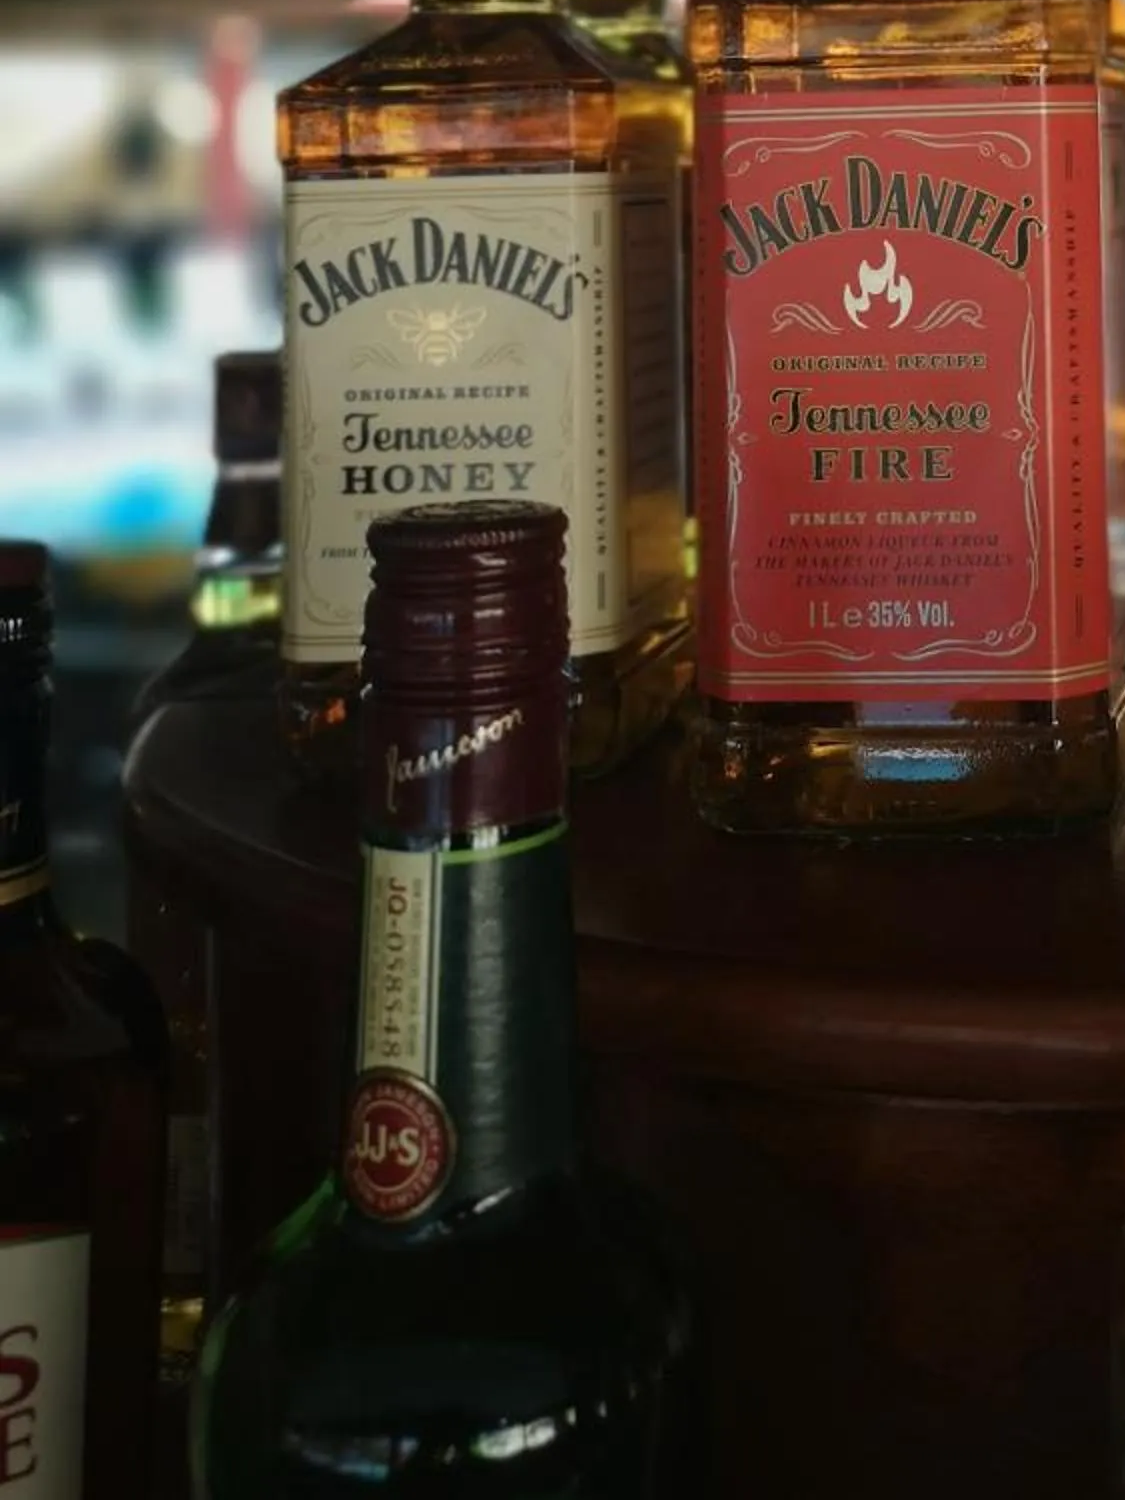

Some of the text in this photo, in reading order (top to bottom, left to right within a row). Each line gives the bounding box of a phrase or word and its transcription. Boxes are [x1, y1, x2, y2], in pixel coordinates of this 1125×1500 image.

[719, 155, 1048, 277] JACK DANIEL'S
[295, 216, 590, 327] JACK DANIEL'S
[771, 353, 987, 372] ORIGINAL RECIPE
[343, 384, 530, 403] ORIGINAL RECIPE
[770, 387, 991, 436] Tennessee
[342, 413, 534, 454] Tennessee
[341, 462, 536, 496] HONEY
[809, 446, 957, 483] FIRE
[790, 510, 978, 526] FINELY CRAFTED
[868, 601, 911, 628] 35%
[917, 600, 955, 627] Vol.
